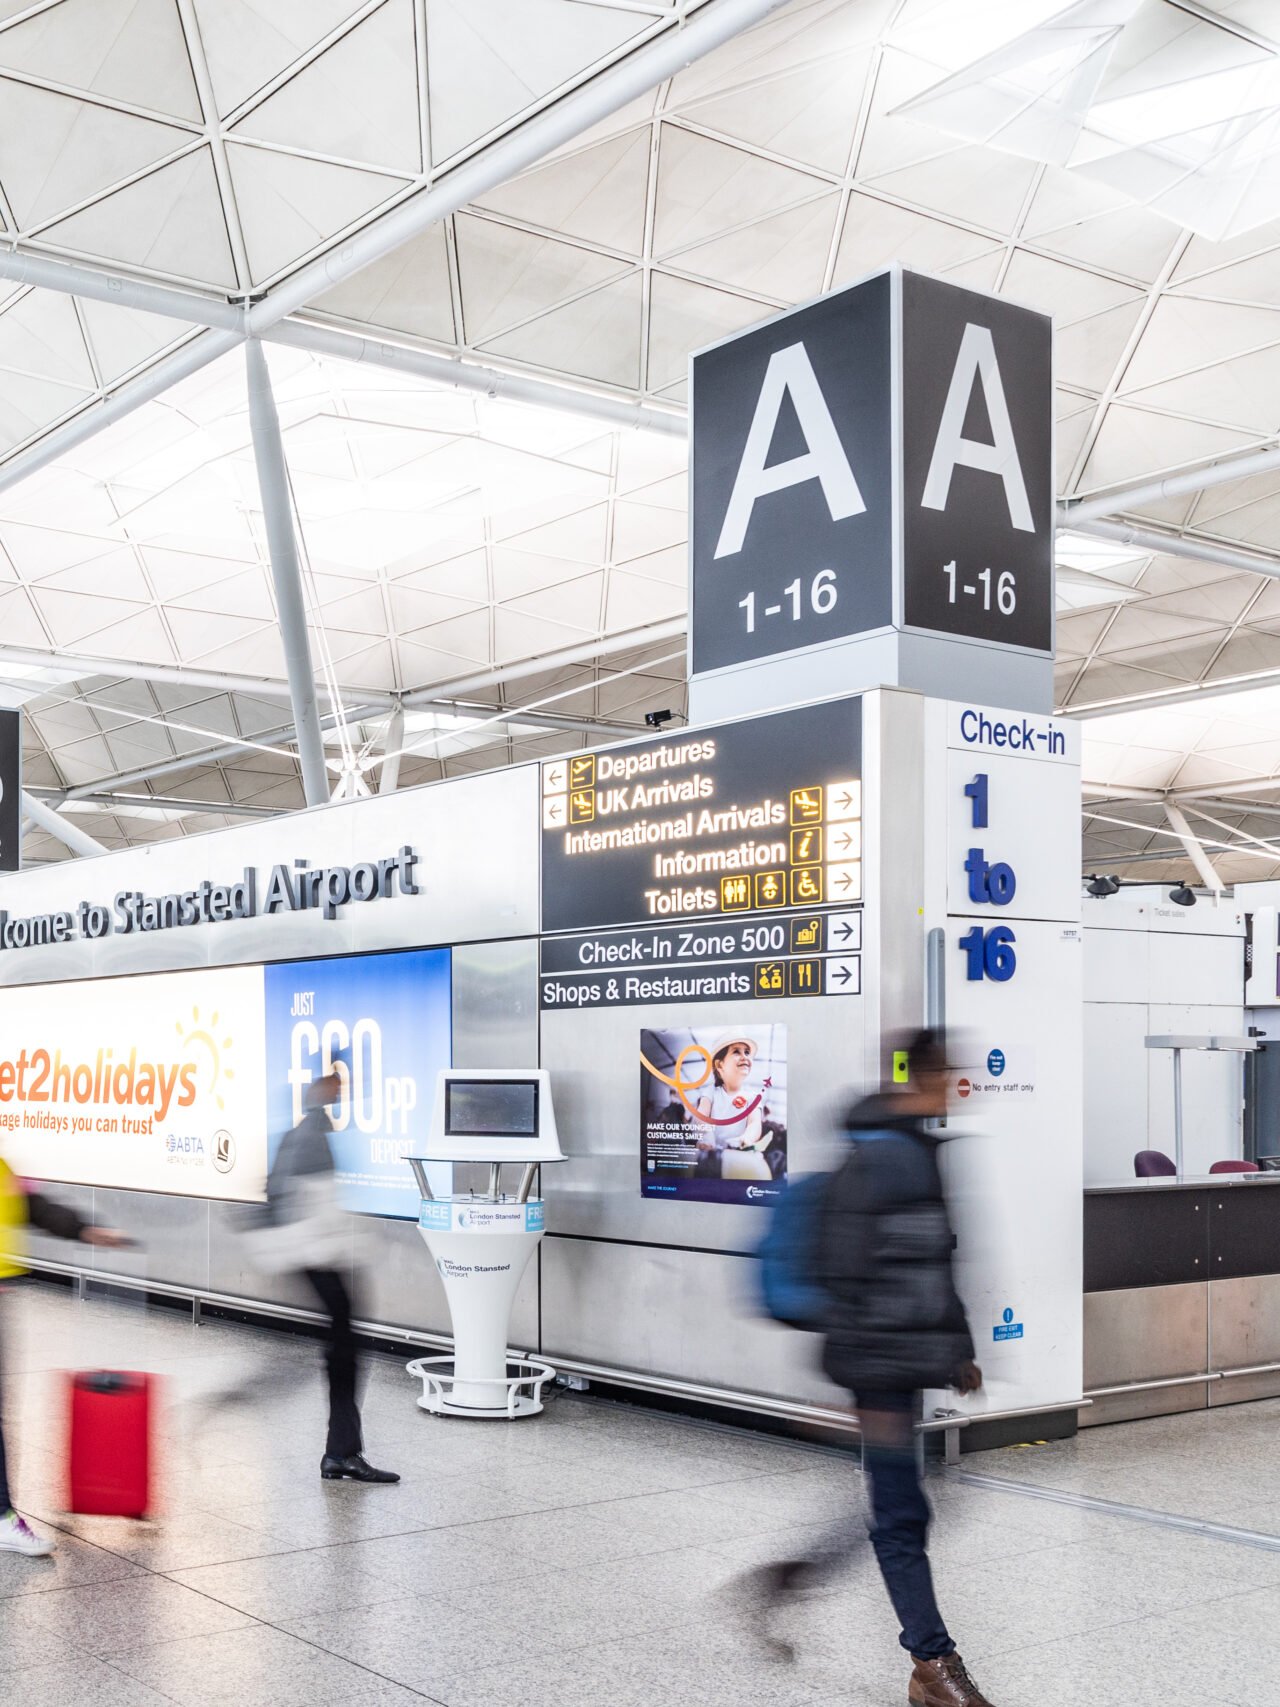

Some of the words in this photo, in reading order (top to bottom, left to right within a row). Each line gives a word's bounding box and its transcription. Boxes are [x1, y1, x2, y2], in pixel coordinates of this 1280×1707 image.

[921, 322, 1035, 533] A
[714, 341, 867, 560] A
[738, 569, 838, 633] 1-16
[943, 560, 1016, 615] 1-16
[960, 710, 1065, 755] Check-in
[597, 740, 716, 780] Departures
[597, 787, 629, 814] UK
[631, 774, 714, 809] Arrivals
[964, 773, 988, 828] 1
[565, 812, 693, 855] International
[696, 800, 786, 835] Arrivals
[654, 841, 787, 877] Information
[964, 848, 1016, 905] to
[76, 900, 111, 939] to
[114, 866, 256, 934] Stansted
[263, 845, 419, 920] Airport
[645, 887, 717, 914] Toilets
[578, 936, 672, 964] Check-In
[677, 934, 736, 957] Zone
[741, 925, 785, 952] 500
[959, 925, 1016, 982] 16
[291, 992, 315, 1017] JUST
[543, 981, 601, 1006] Shops
[606, 979, 620, 999] &
[625, 971, 751, 998] Restaurants
[984, 1084, 1000, 1092] entry
[1021, 1084, 1034, 1092] only
[23, 1110, 69, 1135] holidays
[71, 1115, 93, 1134] you
[95, 1116, 118, 1133] can
[122, 1115, 153, 1136] trust
[681, 1123, 715, 1131] YOUNGEST
[685, 1132, 704, 1140] SMILE
[177, 1137, 205, 1153] ABTA
[371, 1139, 417, 1166] DEPOSIT
[422, 1205, 449, 1220] FREE
[445, 1263, 472, 1272] London
[474, 1264, 511, 1272] Stansted
[447, 1270, 468, 1278] Airport
